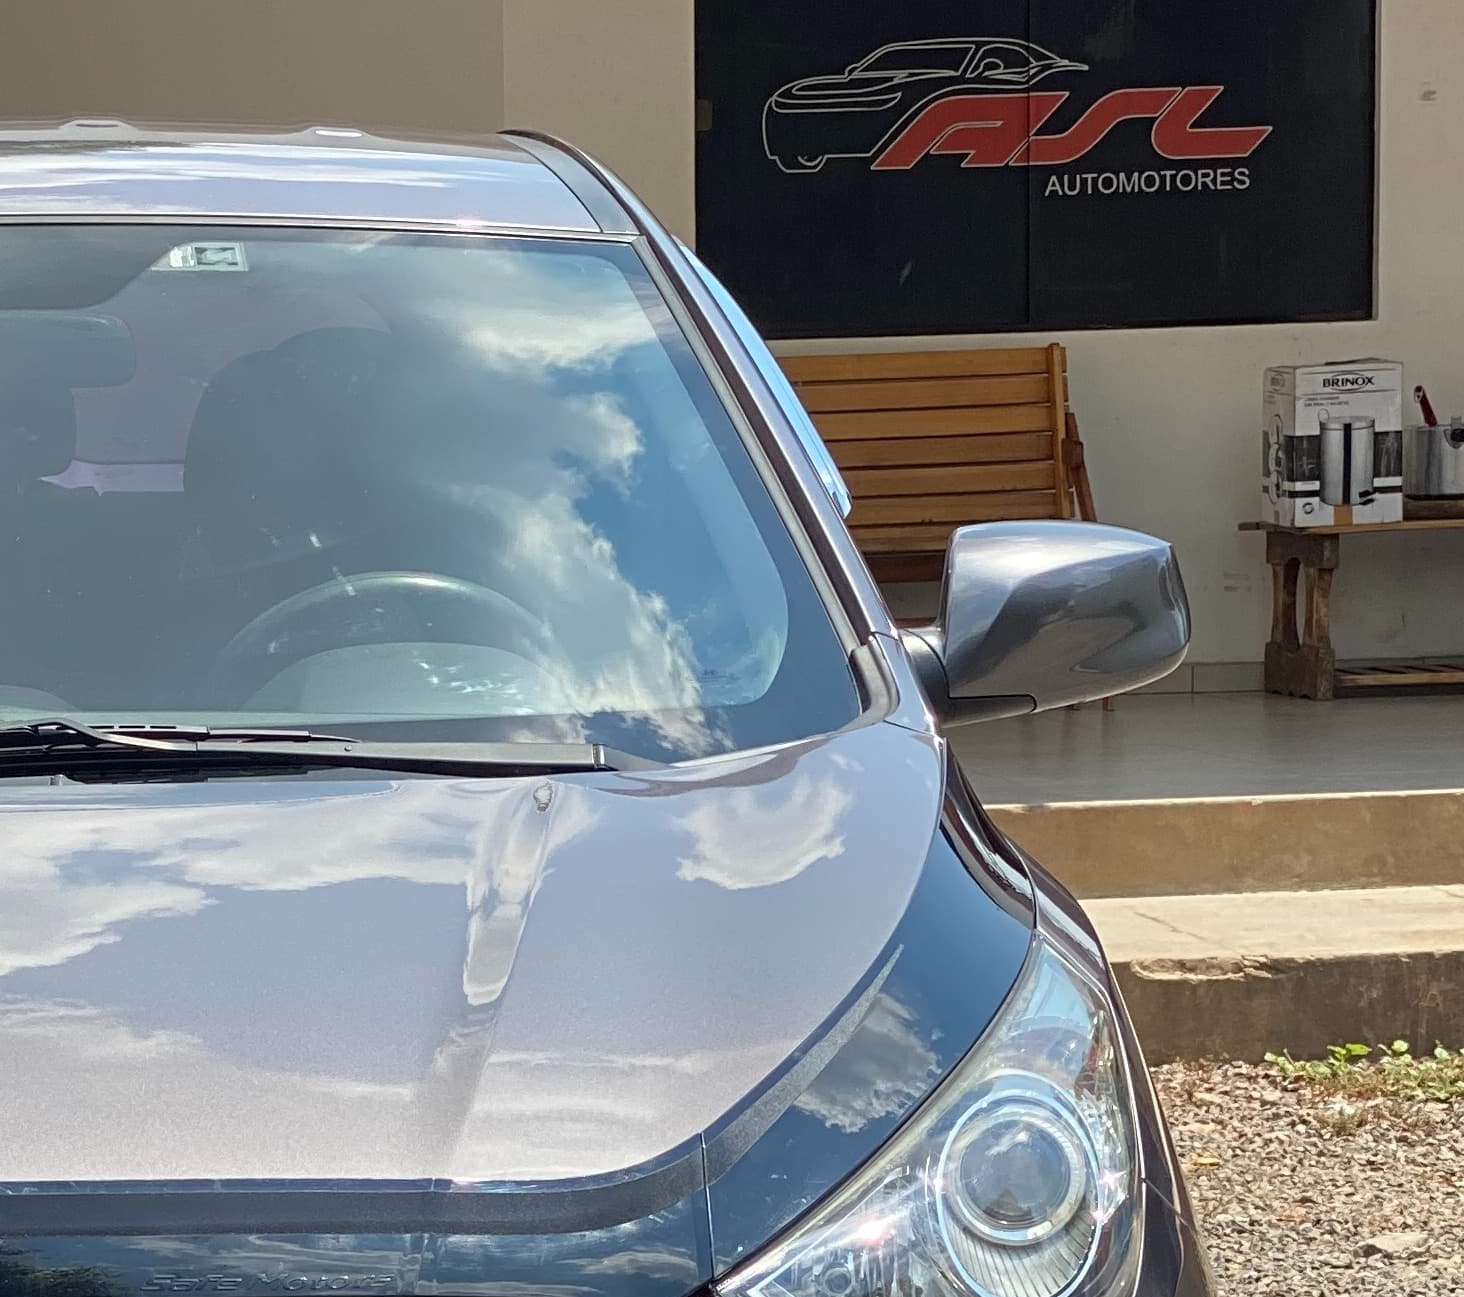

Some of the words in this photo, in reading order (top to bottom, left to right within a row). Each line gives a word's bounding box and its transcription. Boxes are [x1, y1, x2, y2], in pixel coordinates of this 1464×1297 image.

[870, 85, 1273, 170] ASL
[1044, 167, 1250, 197] AUTOMOTORES
[1322, 375, 1376, 388] BRINOX
